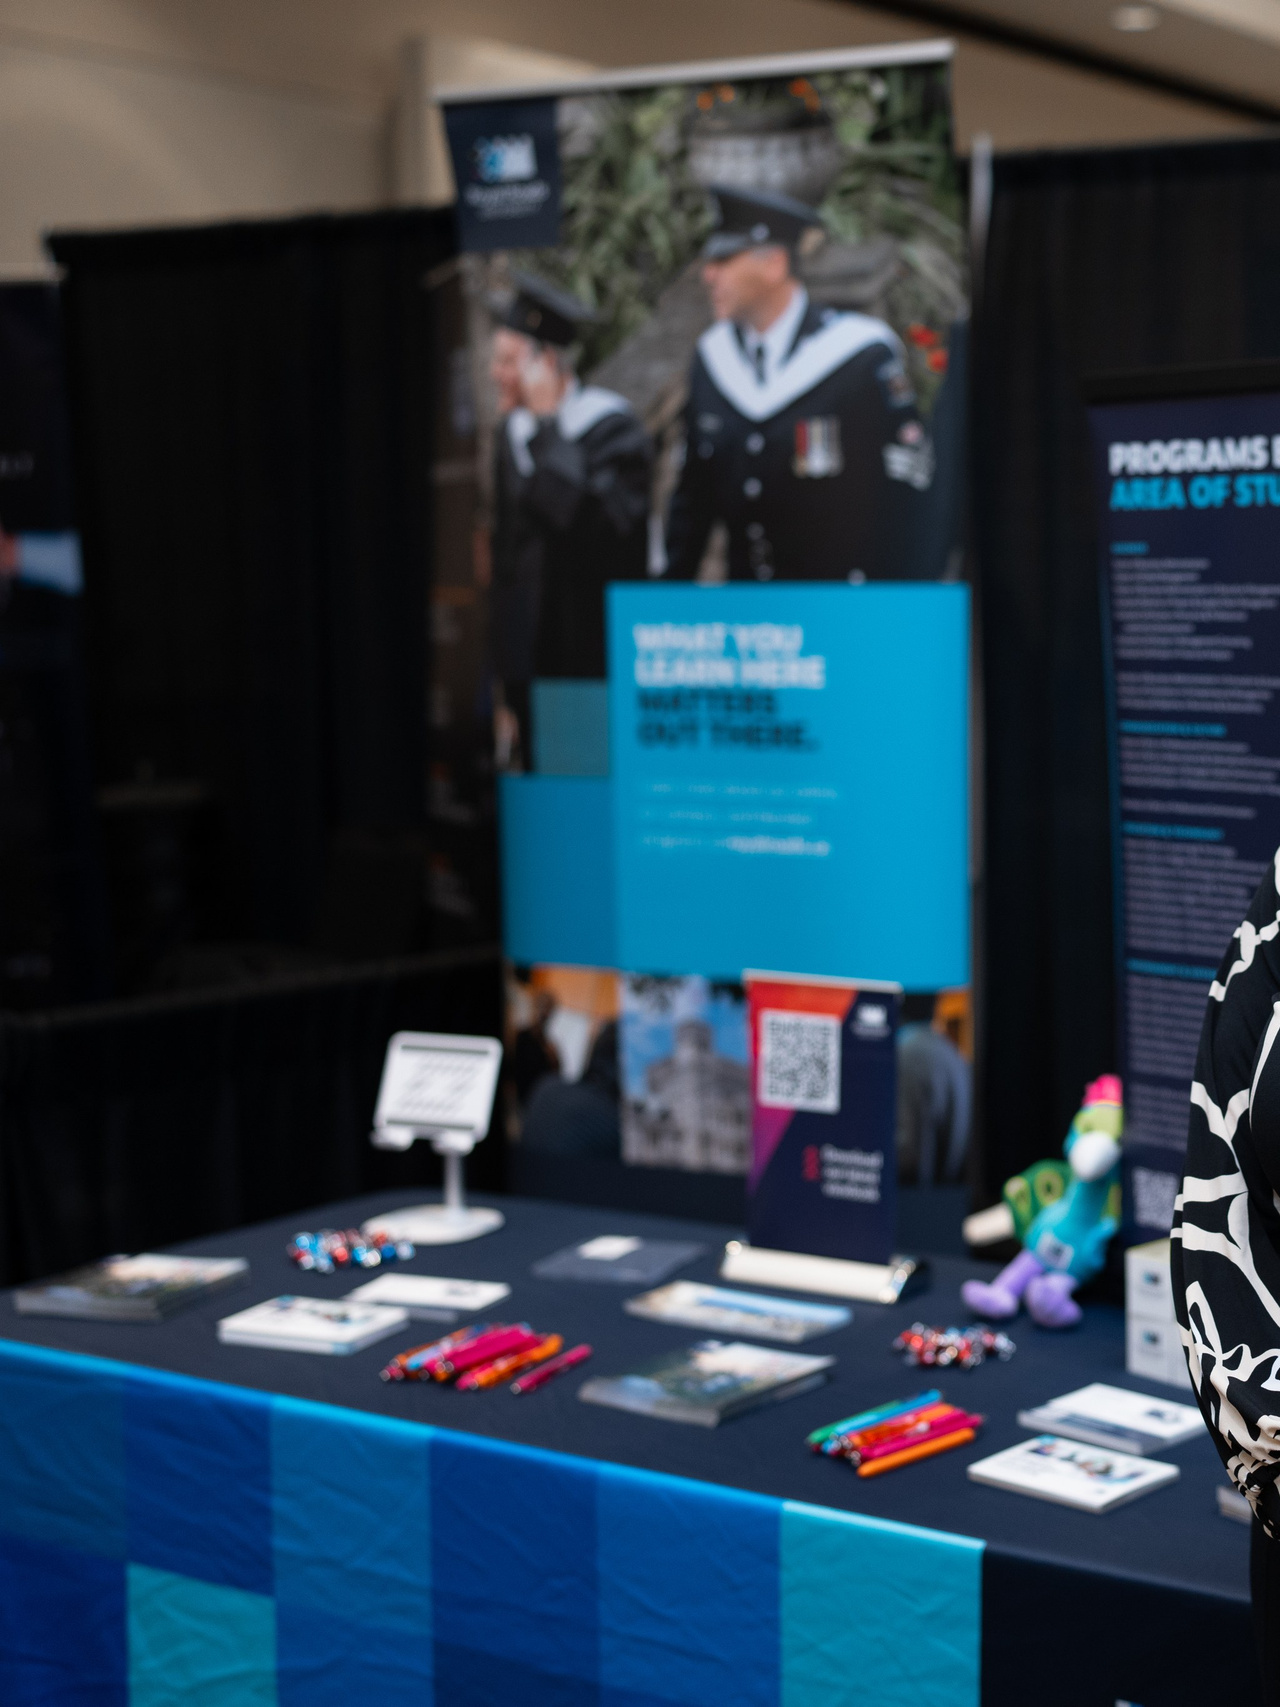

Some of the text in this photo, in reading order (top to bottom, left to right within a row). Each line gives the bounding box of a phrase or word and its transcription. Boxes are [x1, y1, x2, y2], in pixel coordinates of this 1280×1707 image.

[1108, 434, 1269, 476] PROGRAMS
[1109, 476, 1187, 511] AREA
[1188, 474, 1231, 509] OF
[633, 622, 804, 654] WHAT YOU
[634, 654, 826, 690] LEARN HERE
[637, 688, 777, 714] MATTERS
[637, 717, 699, 748] OUT
